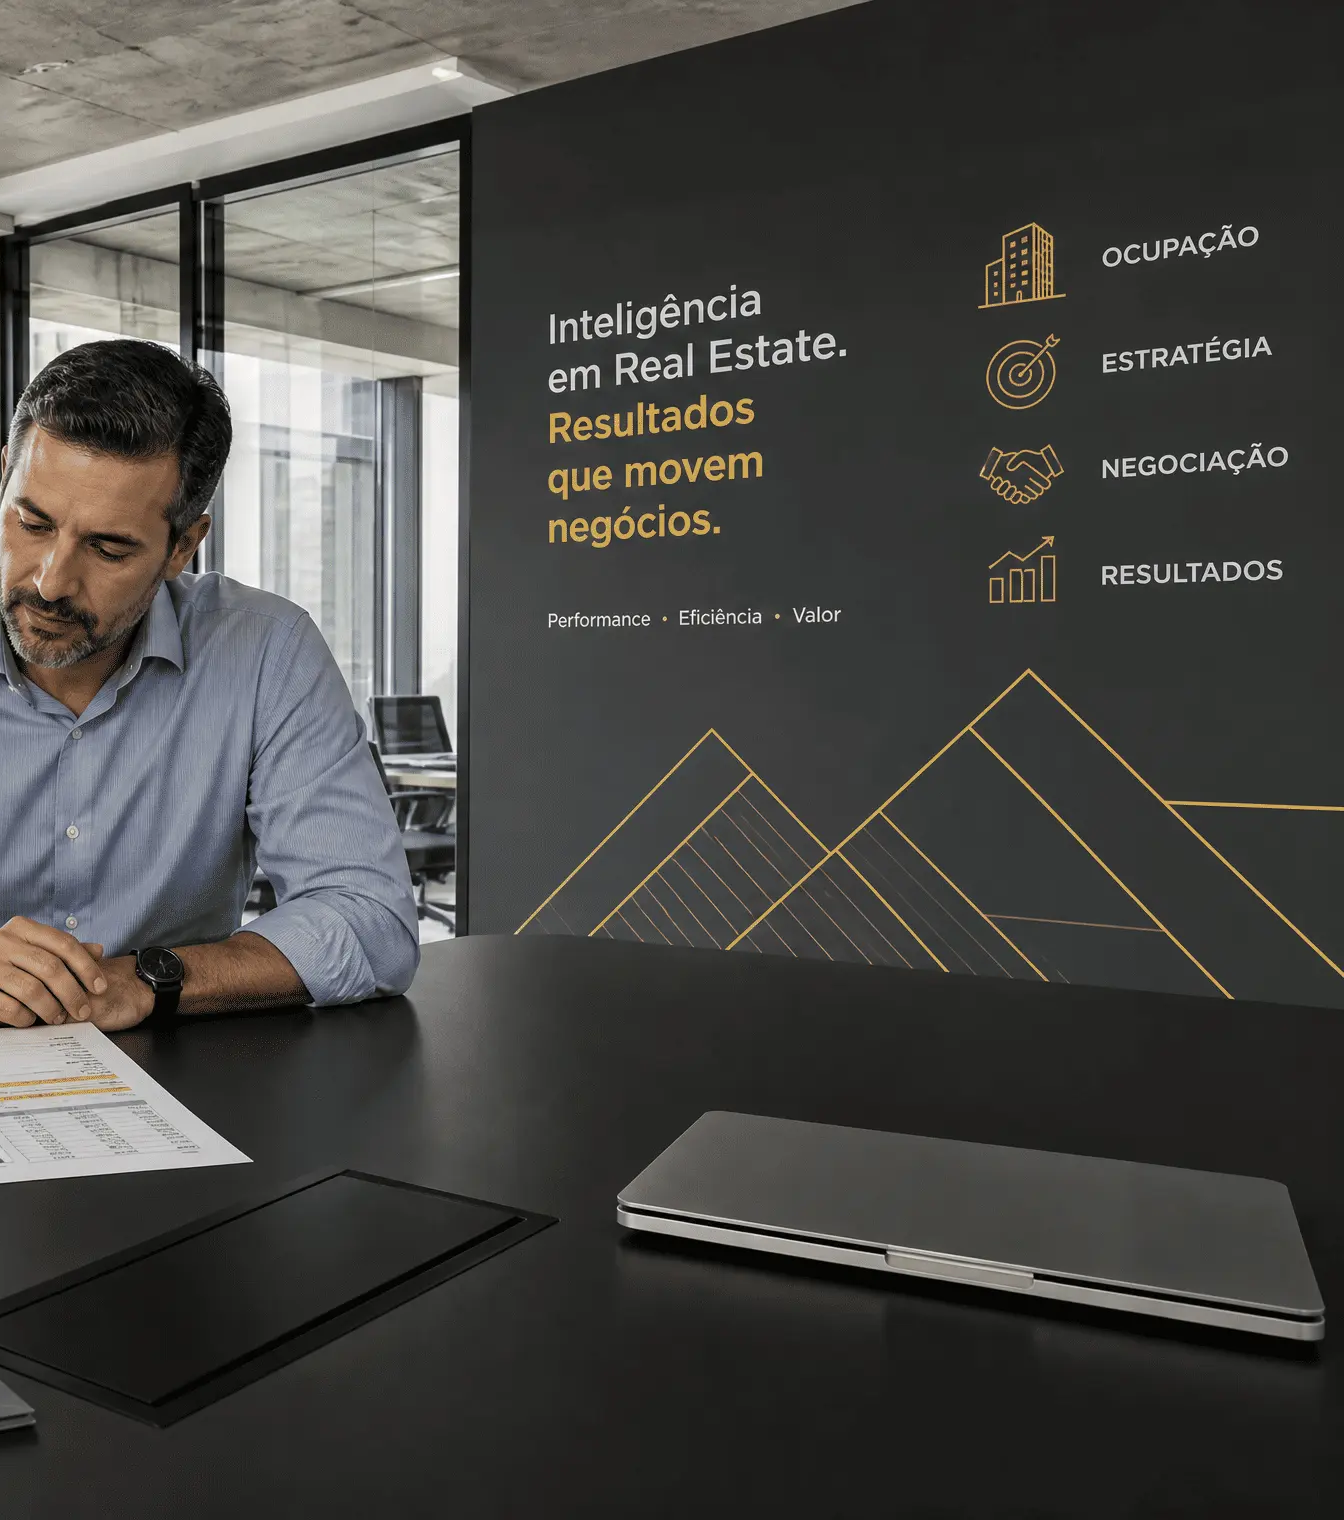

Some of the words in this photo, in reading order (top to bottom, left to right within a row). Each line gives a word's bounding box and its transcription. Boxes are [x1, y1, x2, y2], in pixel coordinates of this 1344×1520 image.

[1102, 223, 1260, 268] OCUPAÇÃO
[549, 284, 762, 345] Inteligência
[548, 364, 601, 394] em
[615, 342, 694, 386] Real
[709, 329, 847, 374] Estate.
[1102, 335, 1273, 374] ESTRATÉGIA
[549, 394, 755, 444] Resultados
[547, 465, 613, 501] que
[625, 451, 763, 488] movem
[1102, 442, 1289, 479] NEGOCIAÇÃO
[548, 503, 721, 549] negócios.
[1101, 559, 1284, 586] RESULTADOS
[548, 611, 651, 629] Performance
[679, 608, 762, 626] Eficiência
[792, 605, 842, 624] Valor
